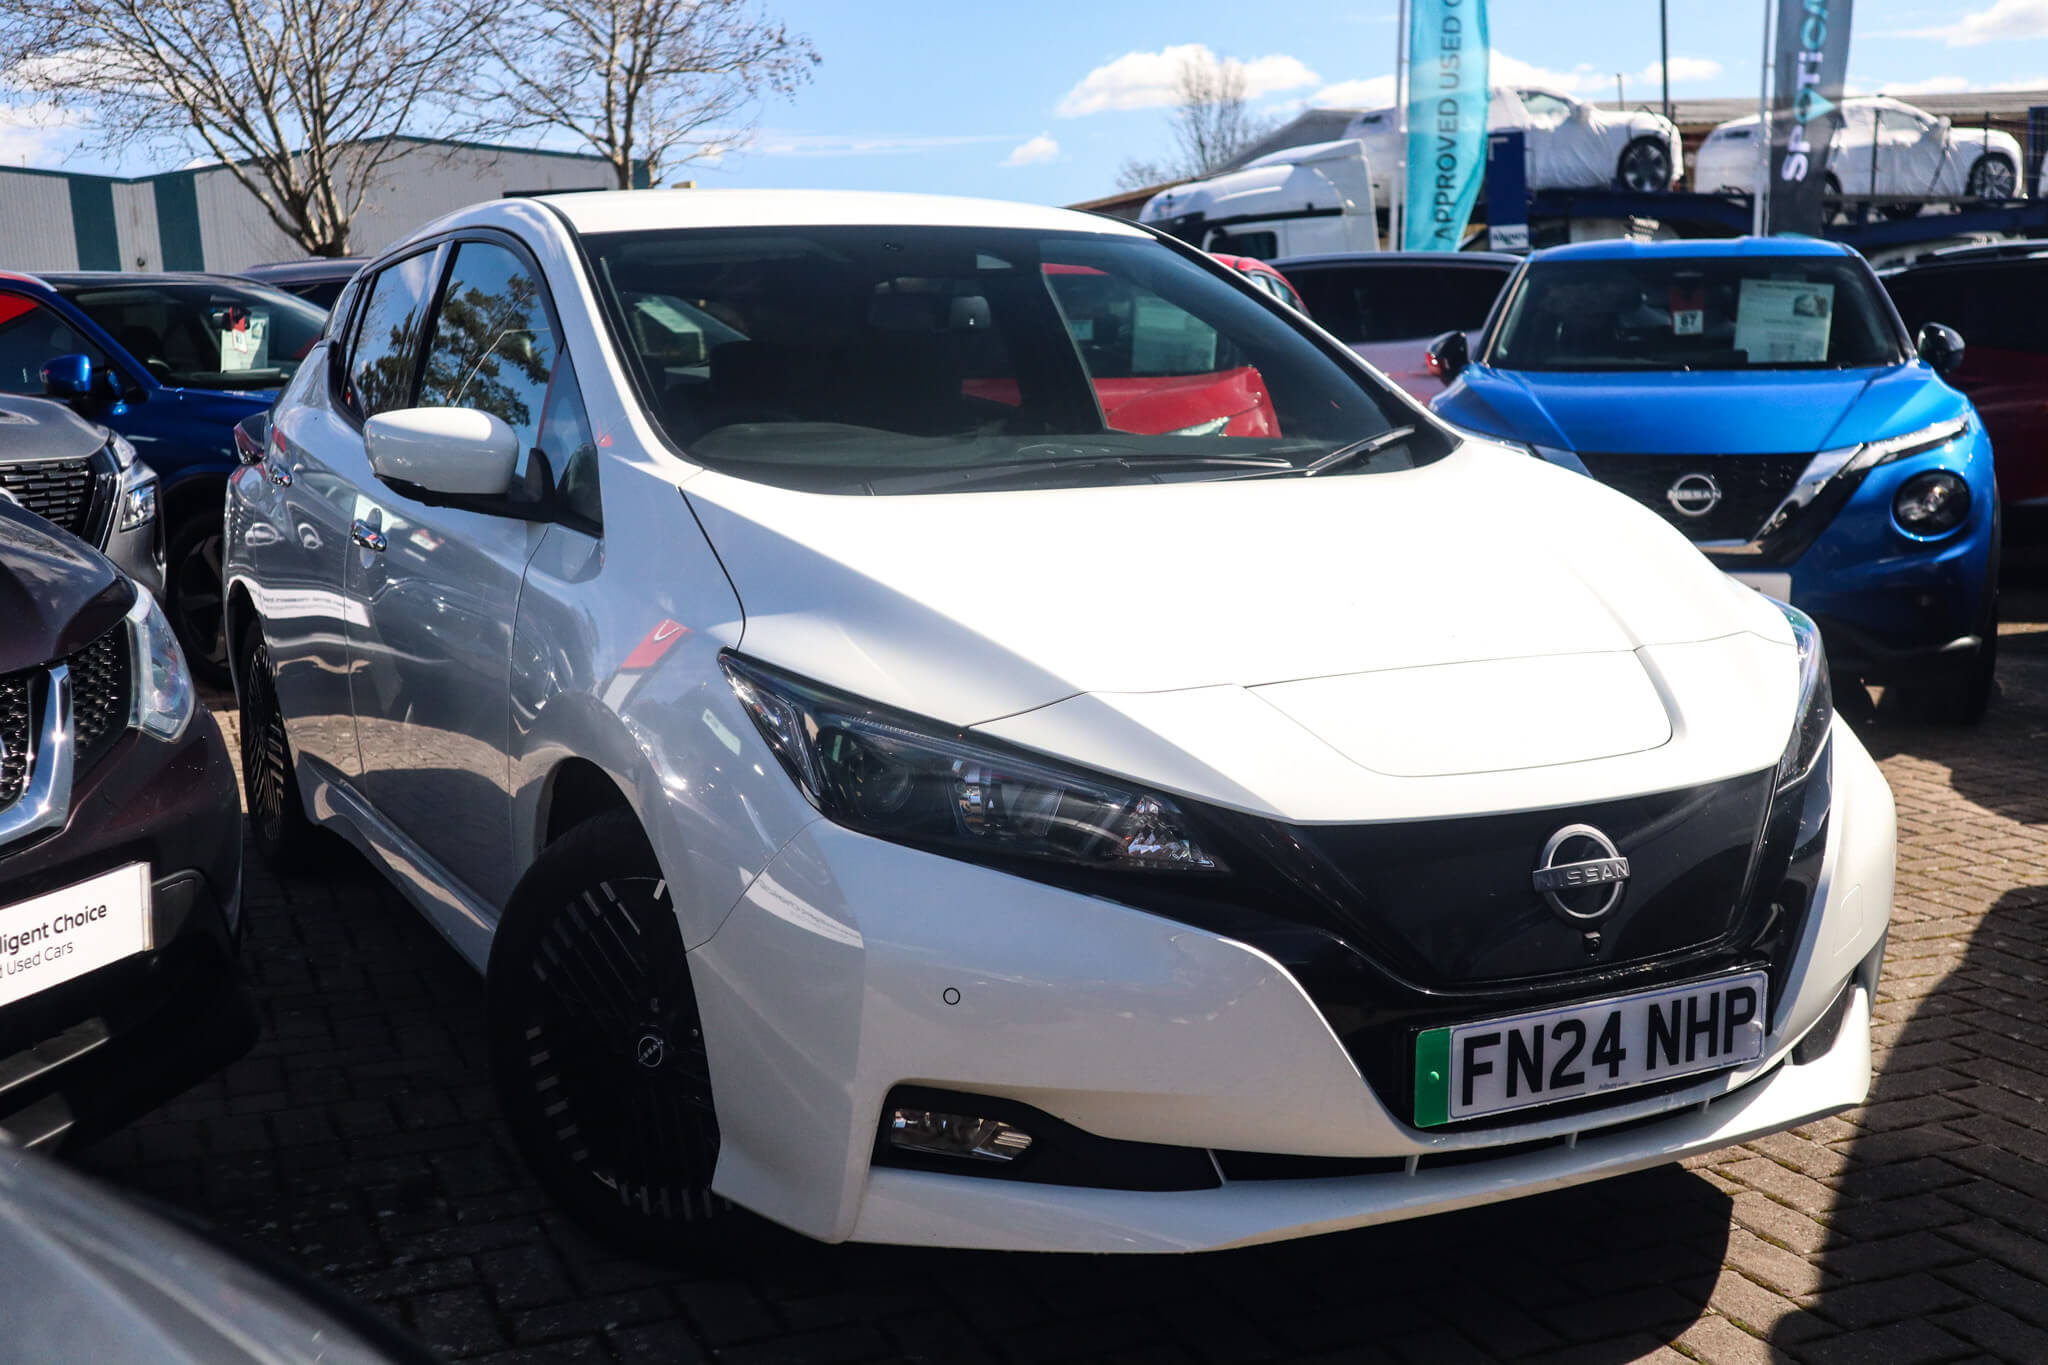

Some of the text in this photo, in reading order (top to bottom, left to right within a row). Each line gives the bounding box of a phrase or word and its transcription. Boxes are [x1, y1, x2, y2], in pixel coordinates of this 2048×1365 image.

[1440, 16, 1462, 89] USED
[1434, 98, 1459, 241] APPROVED
[53, 903, 107, 935] Choice
[7, 948, 41, 976] Used
[44, 940, 74, 961] Cars
[1462, 986, 1758, 1107] FN24 NHP
